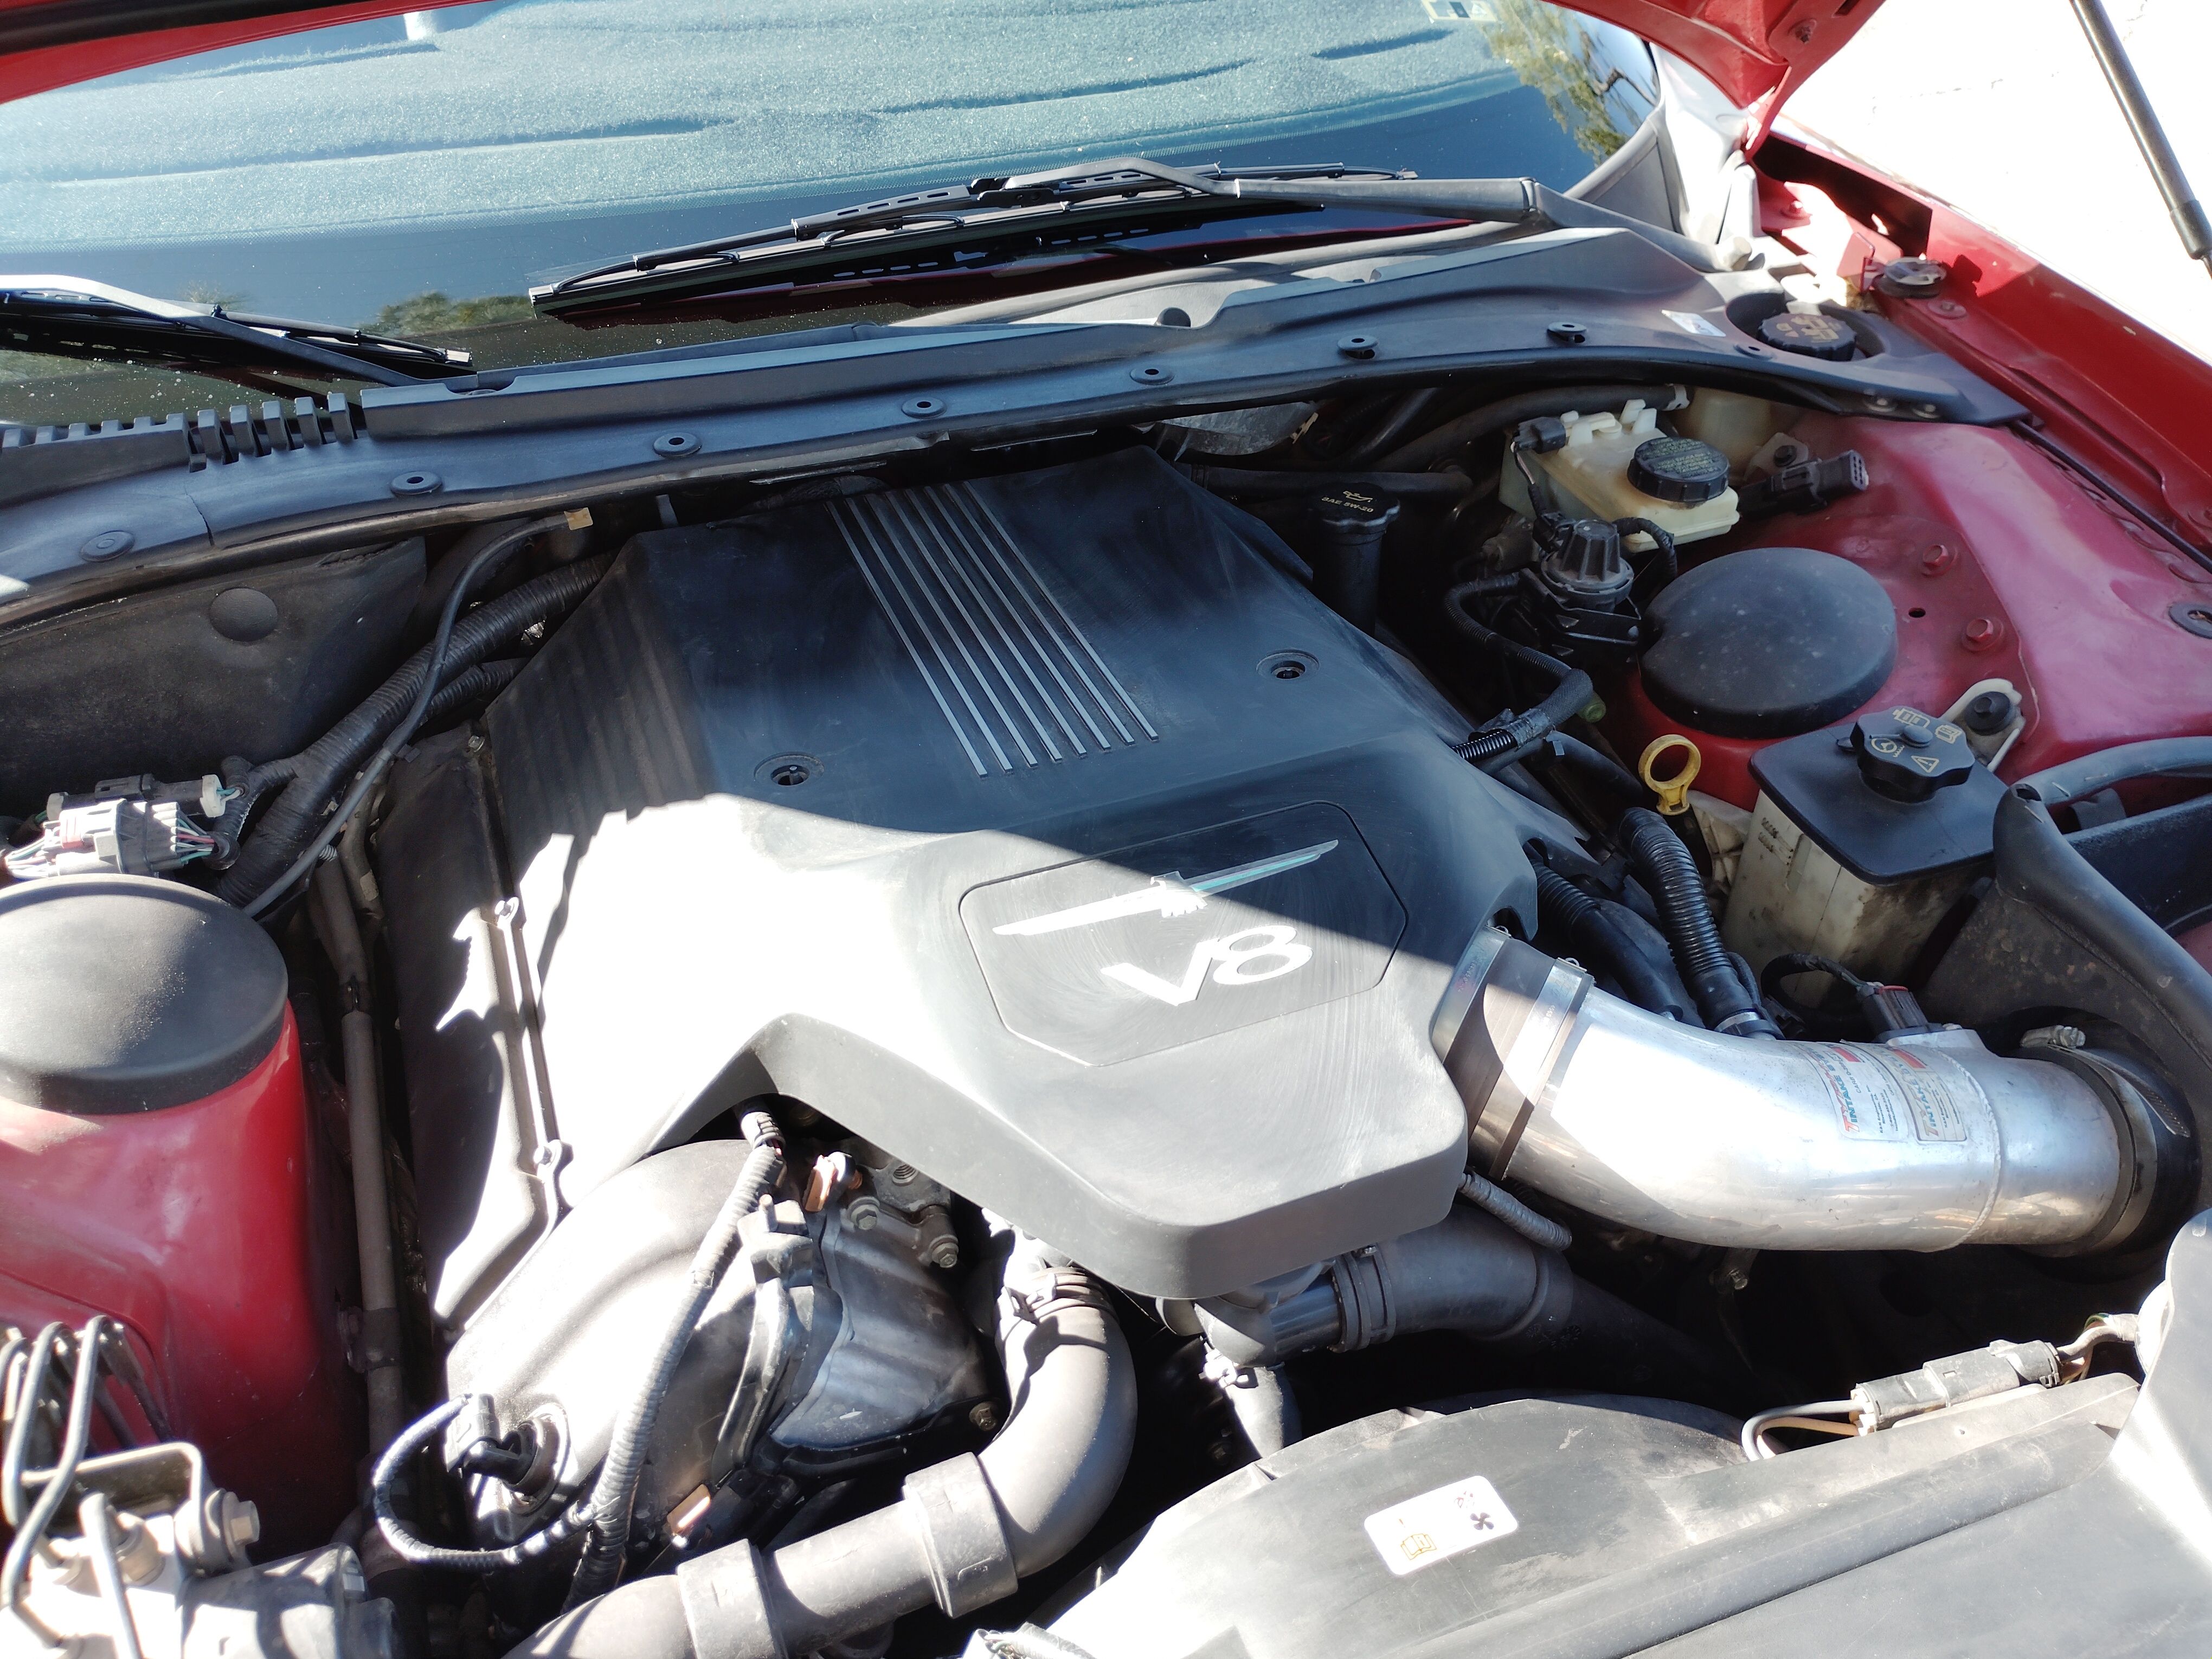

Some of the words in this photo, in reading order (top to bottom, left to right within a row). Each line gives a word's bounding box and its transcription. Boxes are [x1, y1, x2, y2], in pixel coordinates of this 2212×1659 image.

[1321, 497, 1342, 505] SAE
[1343, 502, 1374, 512] 5W-20
[1101, 925, 1313, 1006] V8
[1834, 1075, 1857, 1123] INTAKE
[1849, 1077, 1861, 1093] CARB
